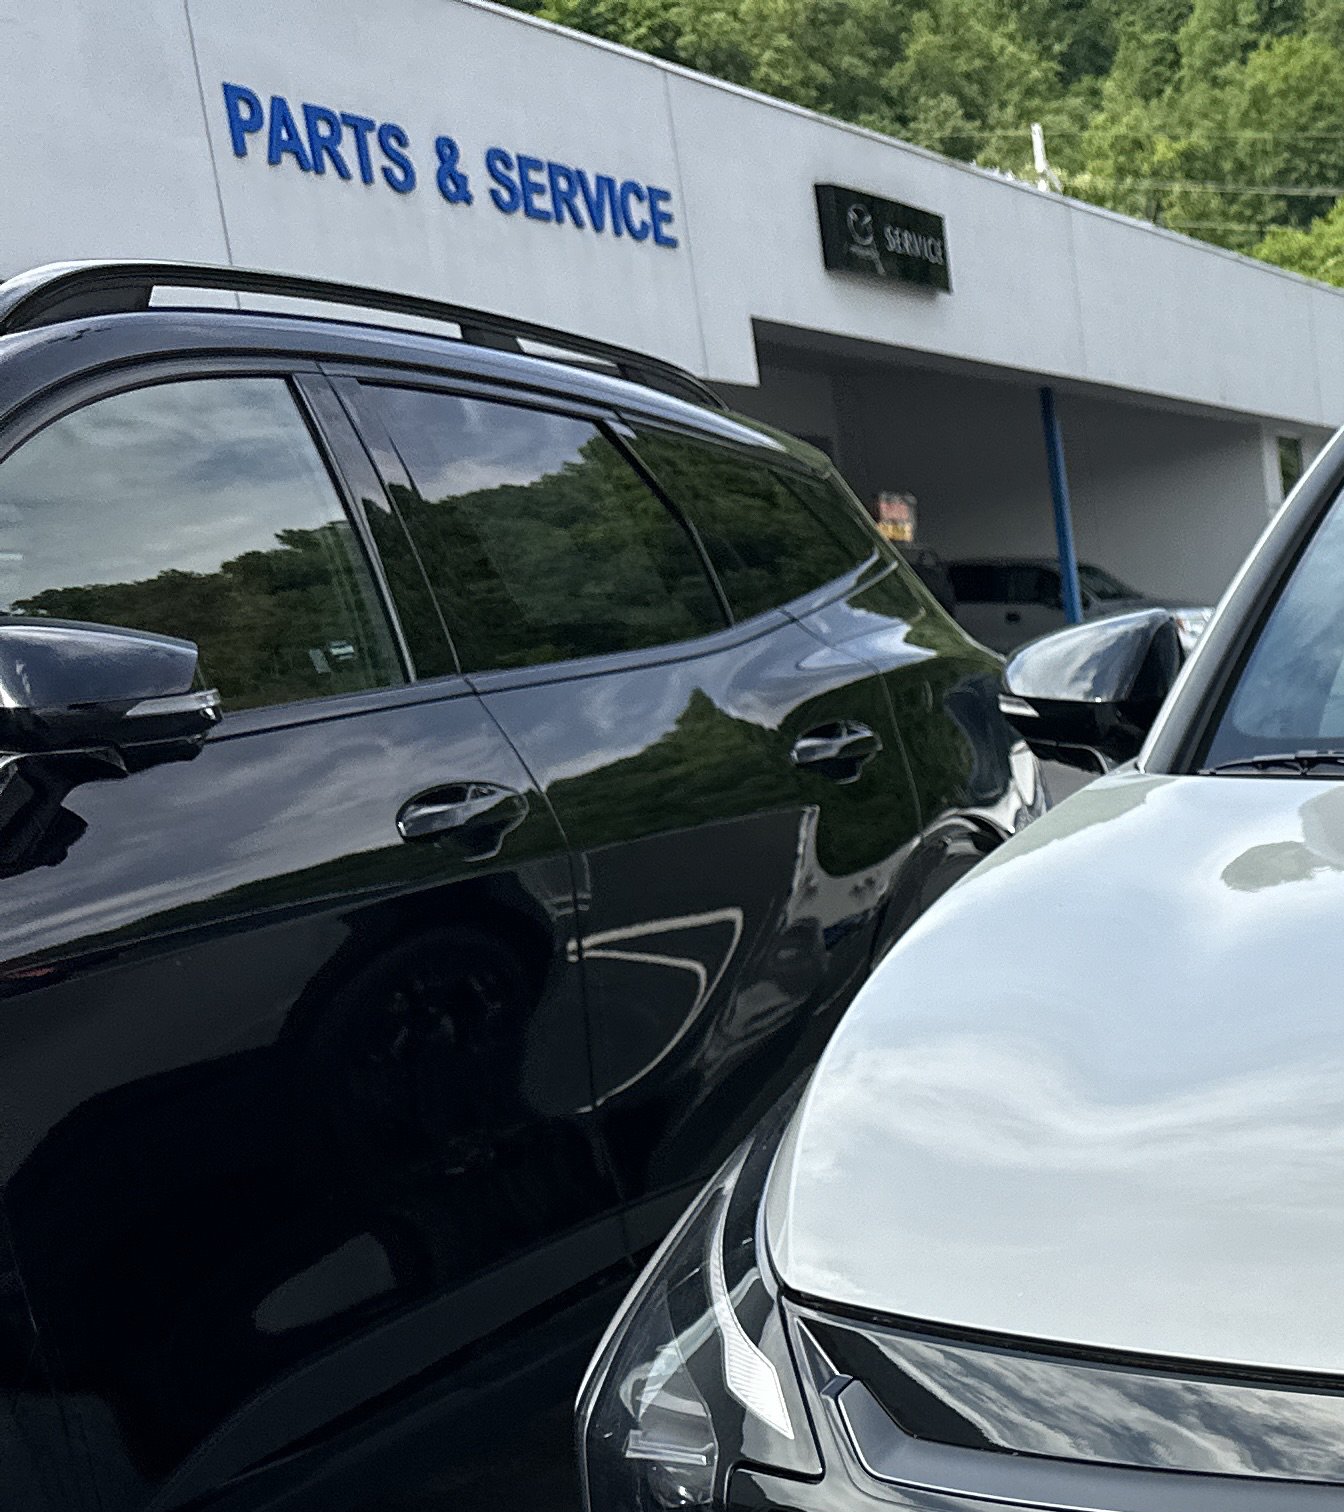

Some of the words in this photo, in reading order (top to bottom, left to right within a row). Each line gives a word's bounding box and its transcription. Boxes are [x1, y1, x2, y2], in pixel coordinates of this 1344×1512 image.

[222, 81, 416, 194] PARTS
[435, 135, 473, 206] &
[485, 146, 679, 249] SERVICE
